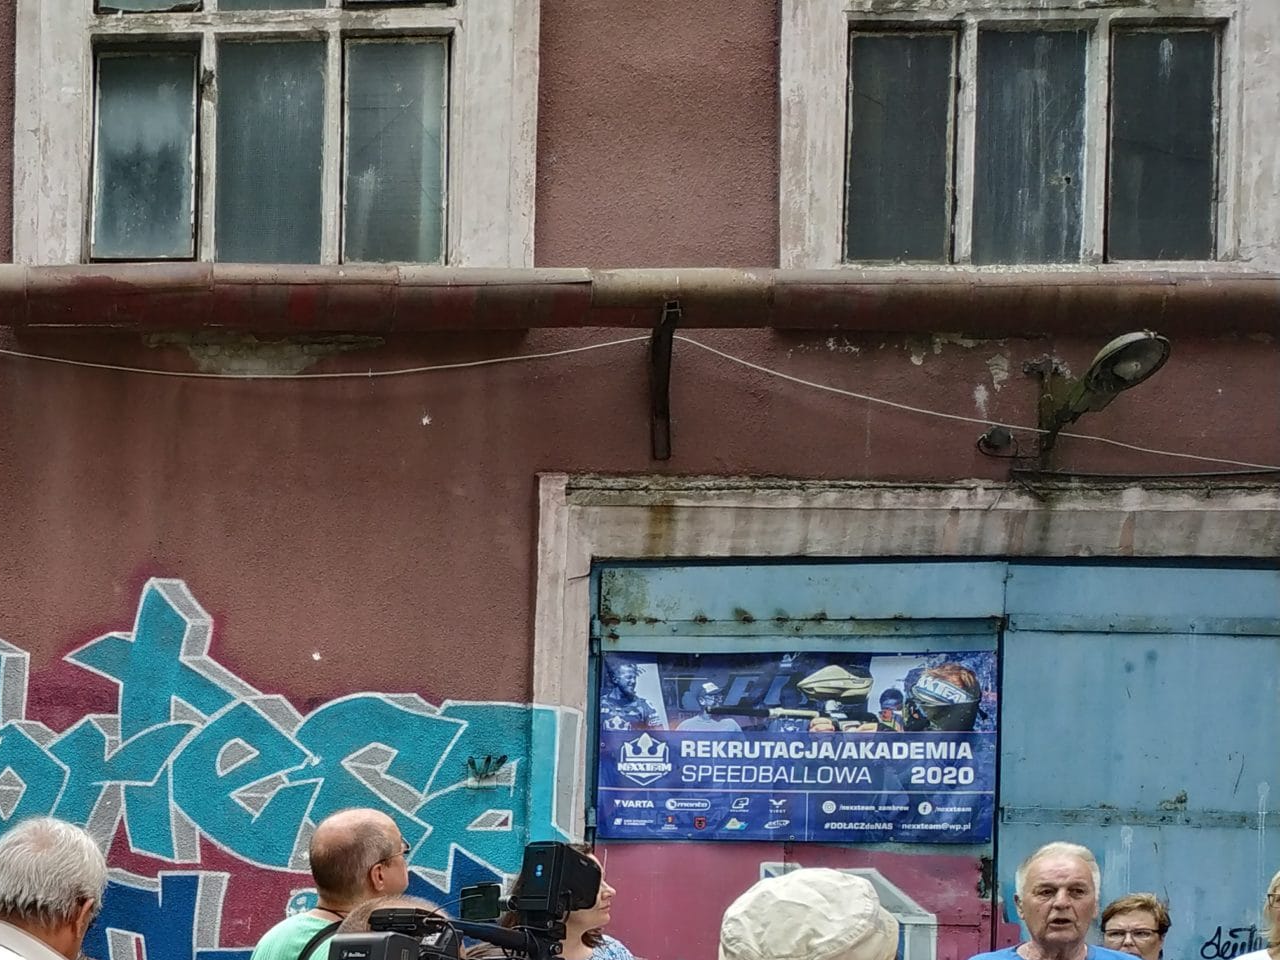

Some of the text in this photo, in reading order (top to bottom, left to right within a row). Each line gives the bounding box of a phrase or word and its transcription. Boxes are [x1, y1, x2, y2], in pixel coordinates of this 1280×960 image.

[680, 740, 974, 760] REKRUTACJA/AKADEMIA
[680, 764, 975, 785] SPEEDBALLOWA 2020
[621, 799, 655, 809] VARTA
